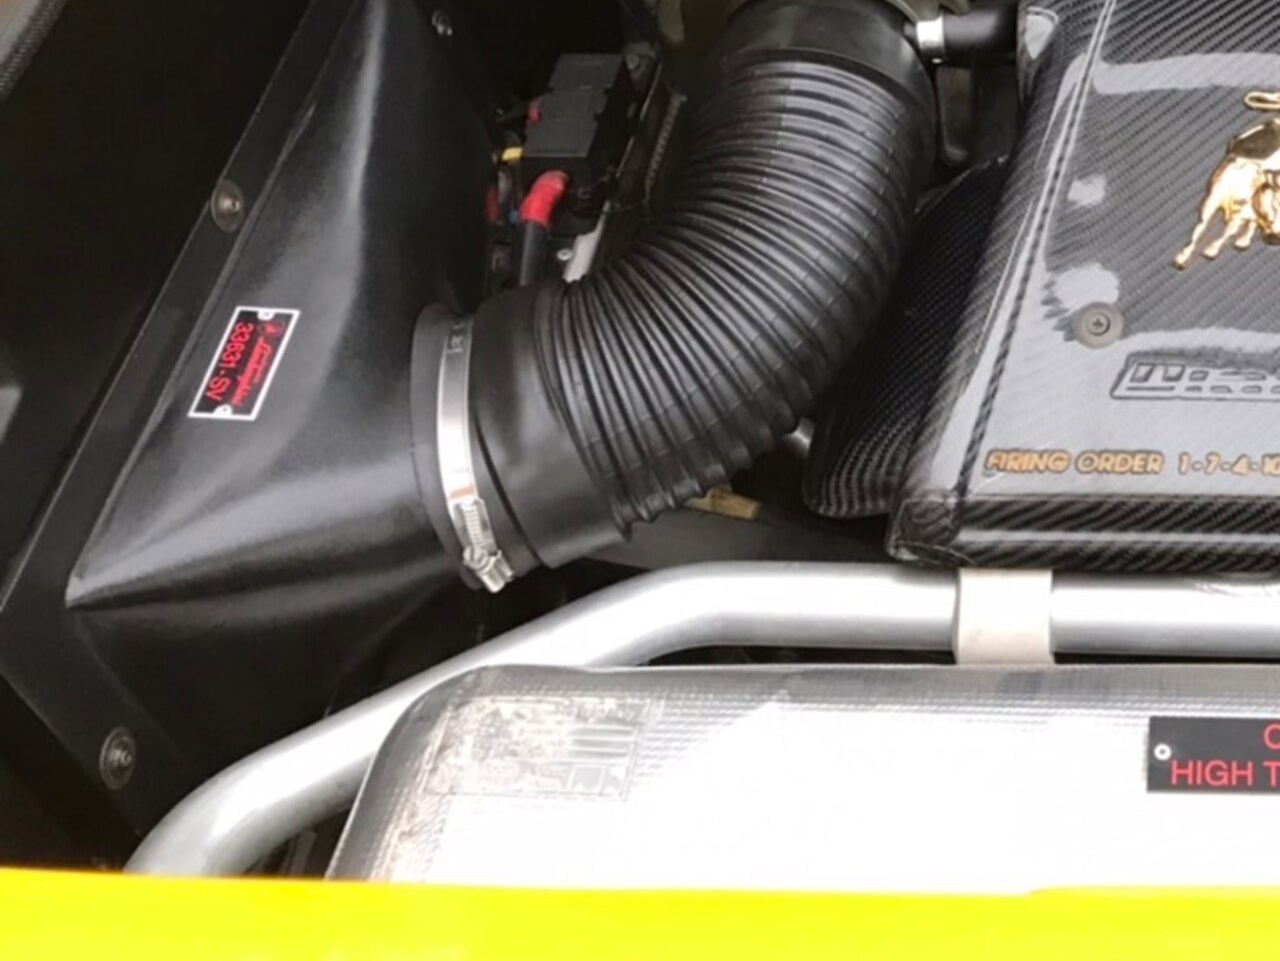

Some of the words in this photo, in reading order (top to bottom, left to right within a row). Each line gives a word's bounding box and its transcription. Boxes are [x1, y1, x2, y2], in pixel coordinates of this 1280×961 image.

[985, 448, 1071, 474] FIRING
[1075, 449, 1165, 475] ORDER
[1170, 758, 1253, 787] HIGH
